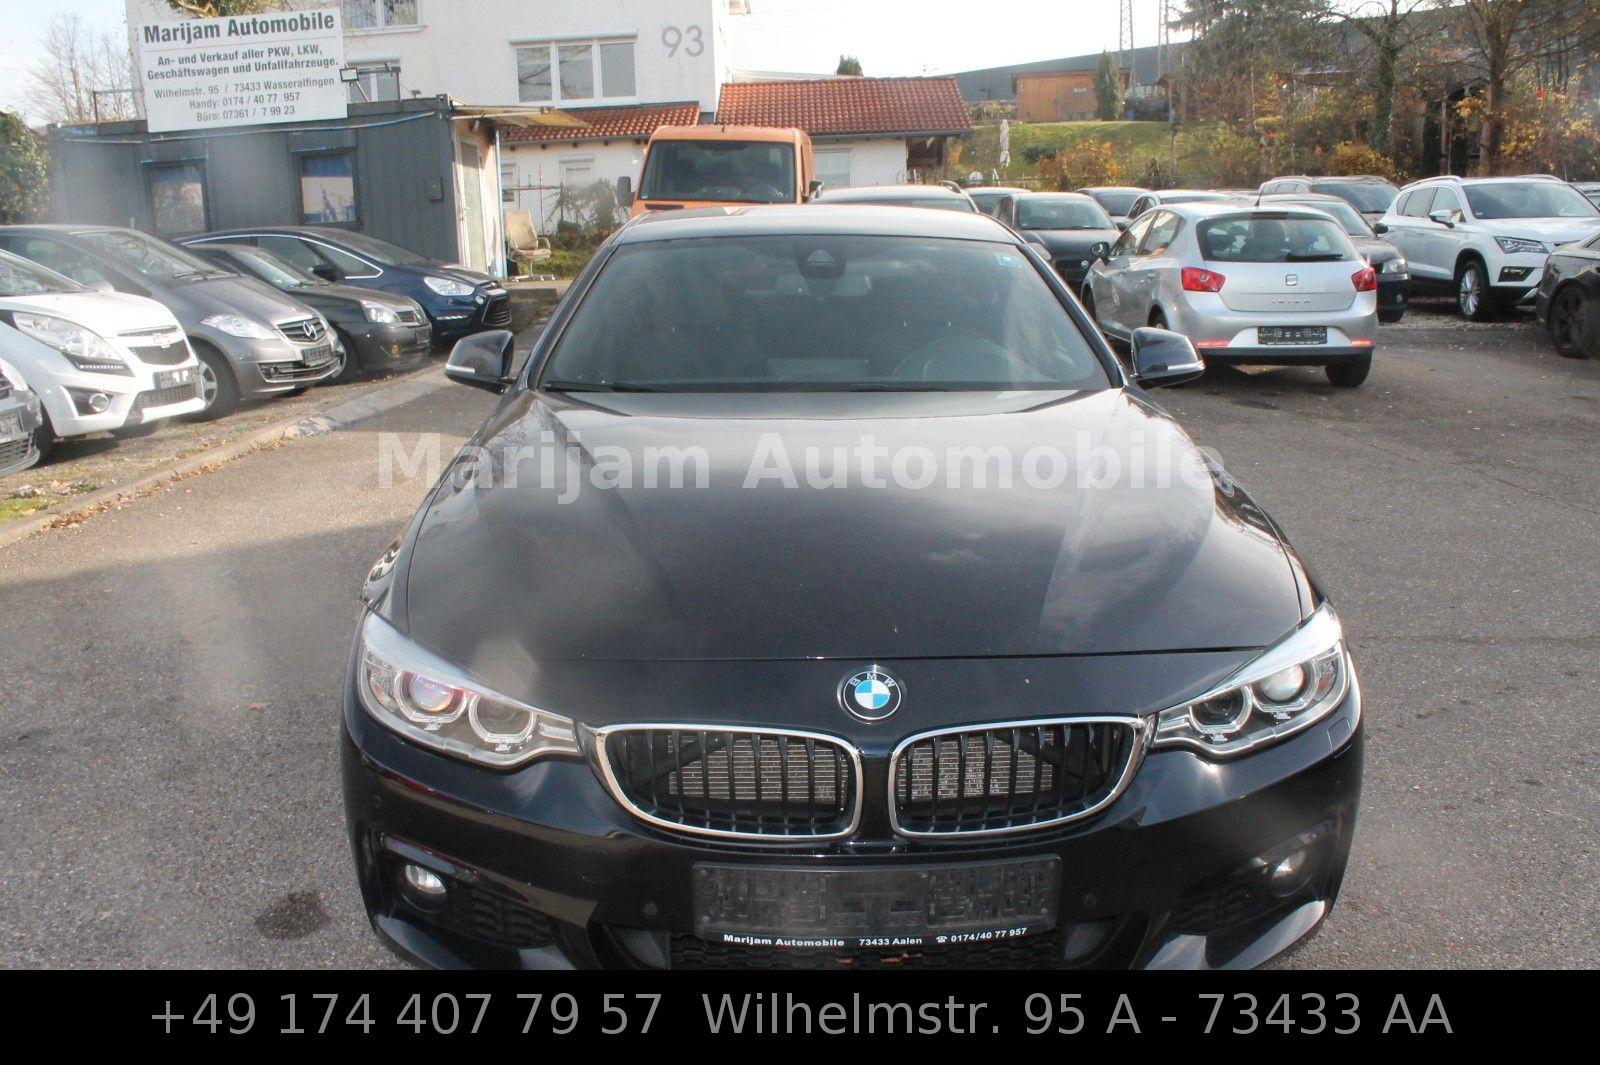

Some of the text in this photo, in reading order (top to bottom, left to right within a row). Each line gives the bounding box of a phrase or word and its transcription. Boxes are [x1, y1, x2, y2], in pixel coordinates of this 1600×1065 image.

[144, 12, 334, 44] Marijam Automobile
[661, 25, 704, 58] 93
[158, 44, 322, 66] An- und Verkauf aller PKW, LKW,
[147, 57, 338, 80] Geschäftswagen und Unfallfahrzeuge.
[154, 87, 205, 99] Wilhelmstr.
[208, 85, 219, 95] 95
[233, 82, 261, 93] 73433
[264, 78, 335, 90] Wasseralfingen
[189, 98, 219, 109] Handy:
[223, 96, 244, 107] 0174
[253, 95, 264, 104] 40
[267, 93, 278, 103] 77
[283, 92, 300, 102] 957
[223, 109, 249, 120] 07361
[262, 107, 267, 116] 7
[270, 106, 281, 115] 99
[284, 105, 295, 115] 23
[850, 671, 896, 688] BMW
[723, 927, 1027, 947] Marijam Automobile 73433 Aalen 0174/40 77 957
